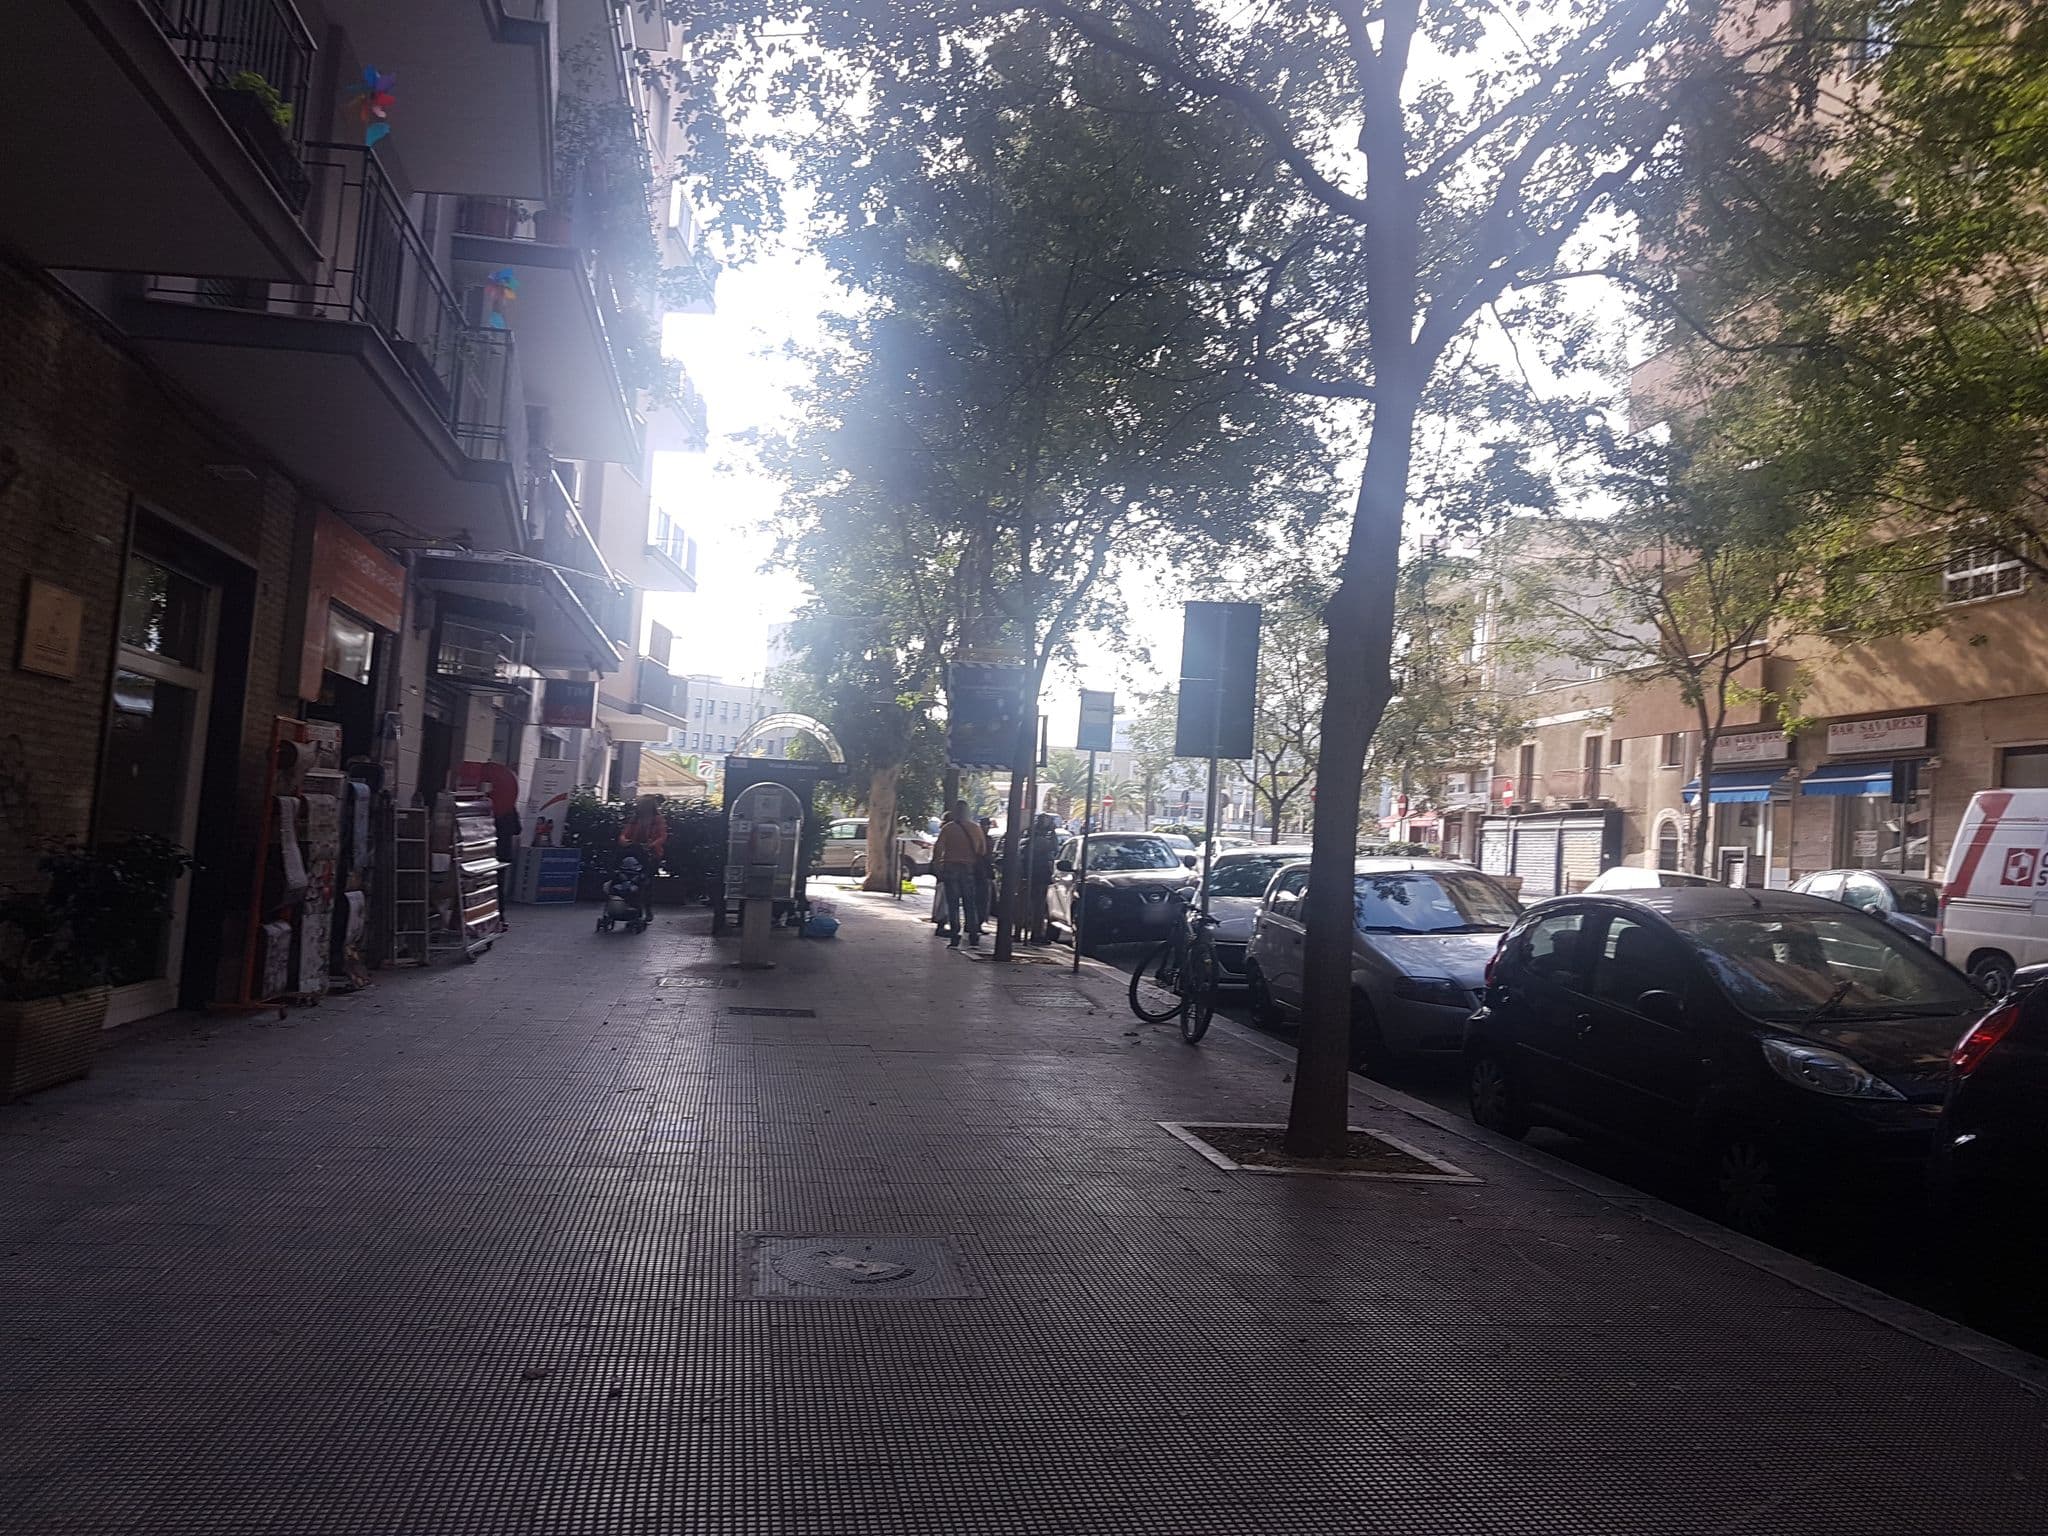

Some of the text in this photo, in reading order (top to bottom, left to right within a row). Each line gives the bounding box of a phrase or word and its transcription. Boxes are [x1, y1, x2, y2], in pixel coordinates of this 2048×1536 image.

[567, 686, 592, 697] TIM
[1830, 724, 1854, 736] BAR
[1859, 717, 1925, 732] SAVARESE
